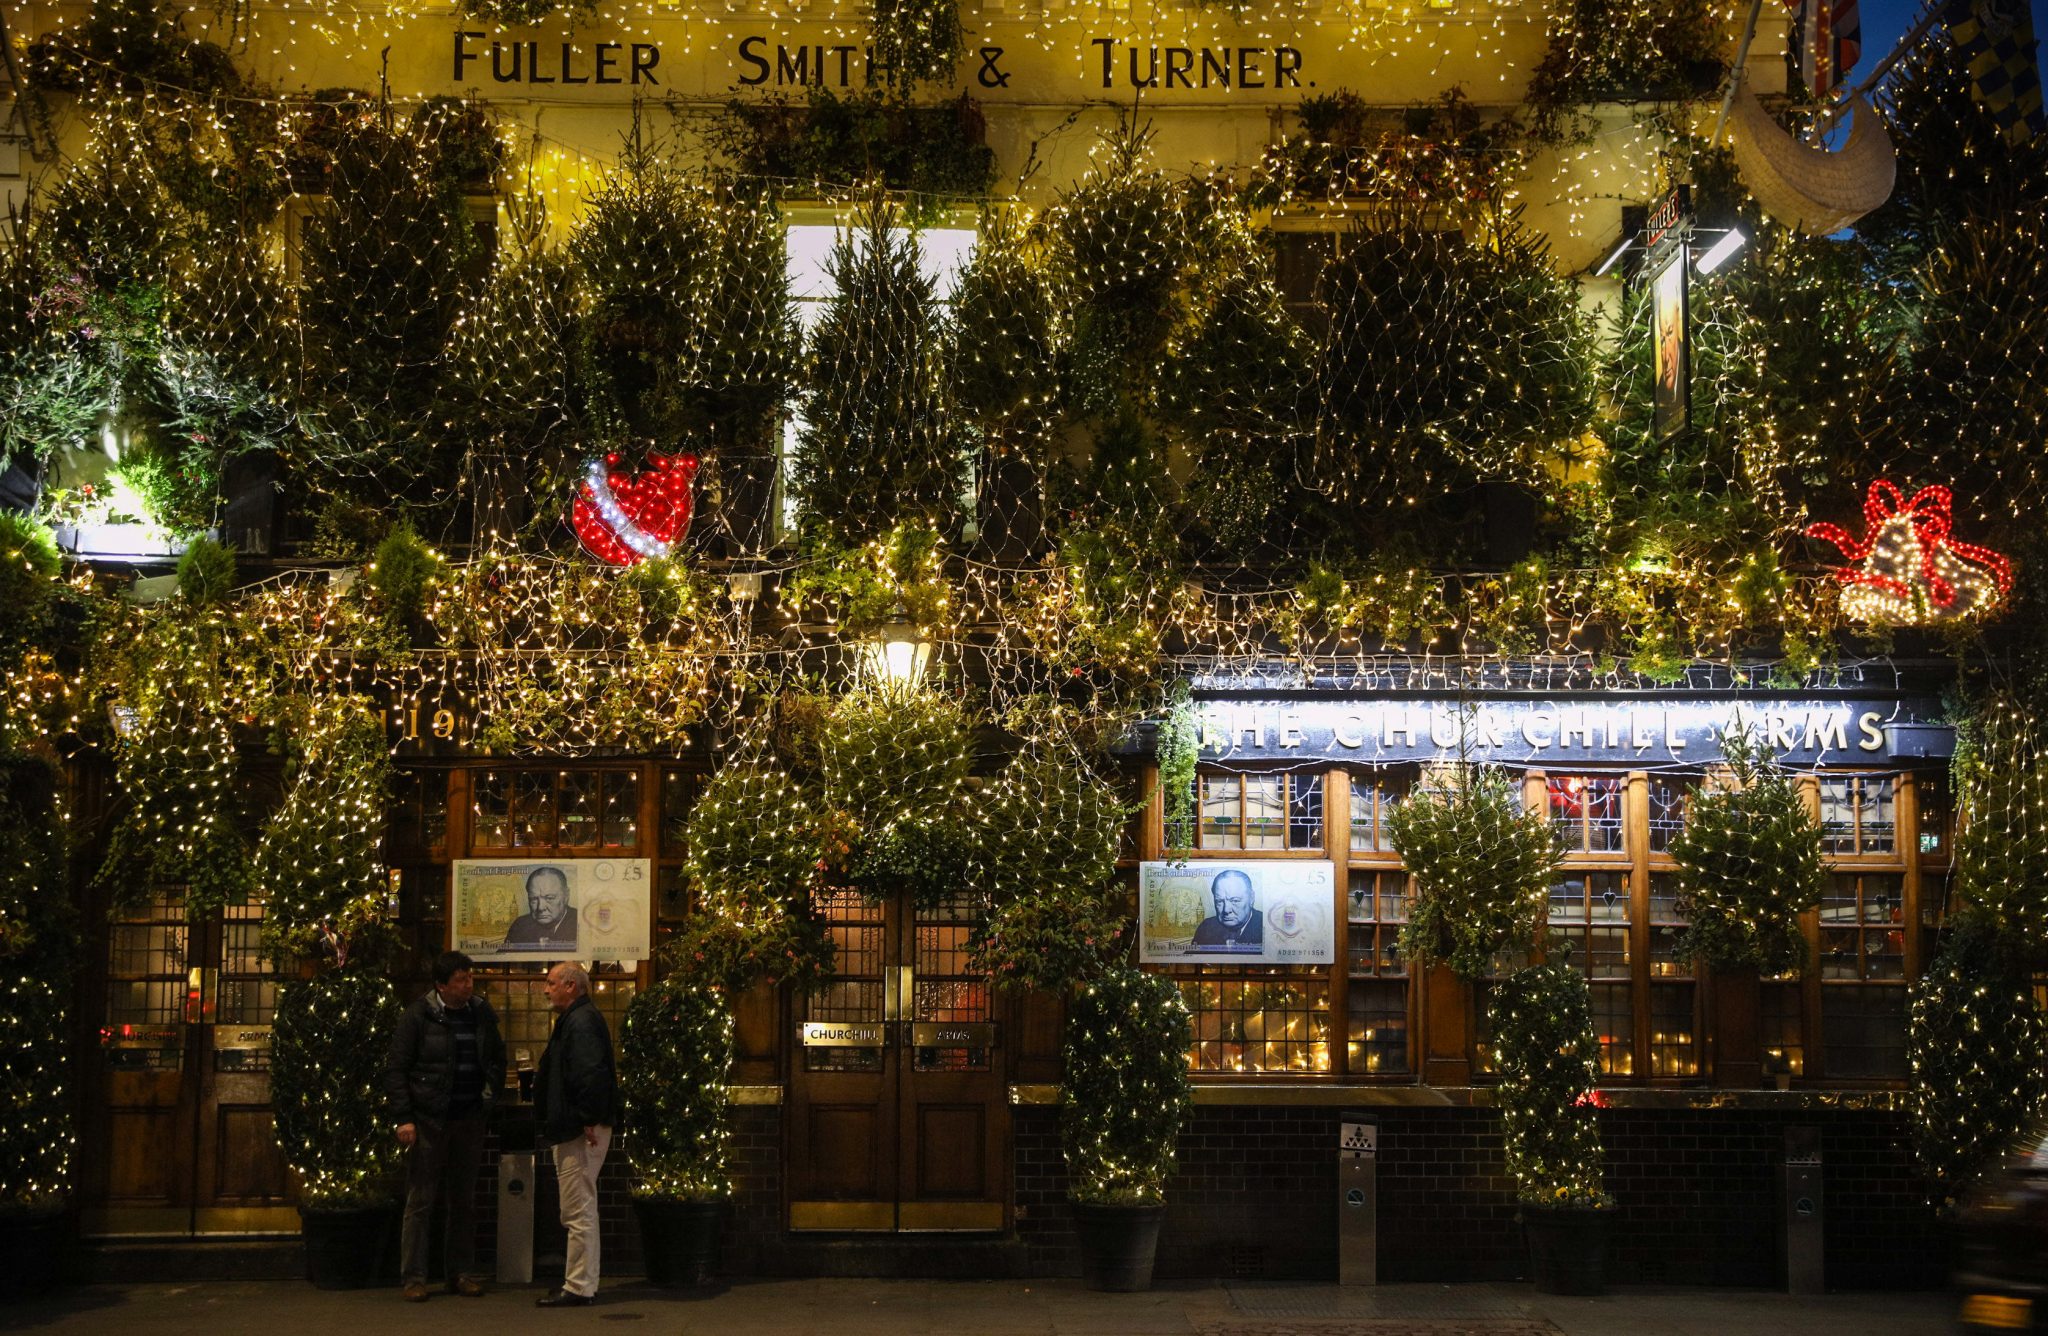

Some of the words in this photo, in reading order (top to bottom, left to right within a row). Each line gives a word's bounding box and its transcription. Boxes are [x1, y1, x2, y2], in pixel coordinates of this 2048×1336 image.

[453, 31, 661, 85] FULLER
[977, 47, 1011, 88] &
[1196, 708, 1302, 748] THE
[1332, 709, 1687, 749] CHURCHILL
[1720, 709, 1882, 751] ARMS
[622, 868, 642, 882] £5
[1307, 871, 1326, 885] £5
[1147, 941, 1166, 951] Five
[810, 1029, 879, 1040] CHURCHILL
[936, 1030, 970, 1040] ARMS
